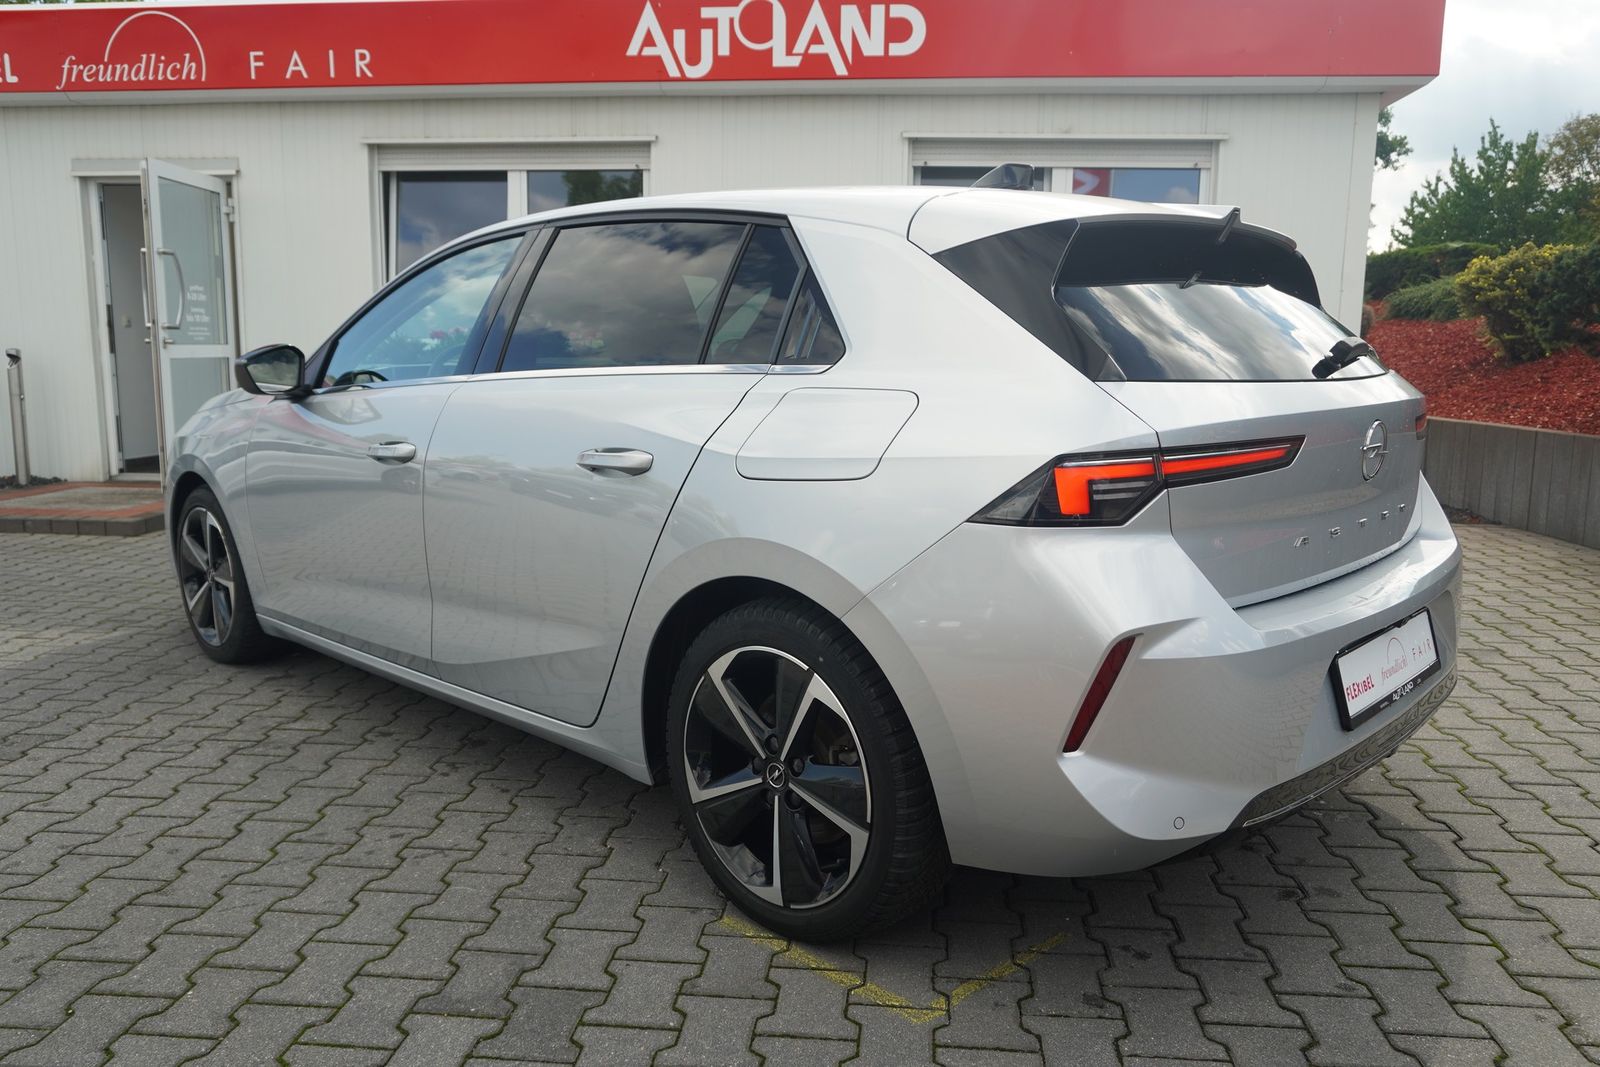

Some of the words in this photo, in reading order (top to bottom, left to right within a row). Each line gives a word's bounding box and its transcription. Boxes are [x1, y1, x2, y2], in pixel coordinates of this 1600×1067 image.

[626, 0, 927, 78] AUTOLAND
[56, 53, 197, 90] freundlich
[248, 48, 374, 80] FAIR
[1346, 674, 1375, 702] FLEXIBEL
